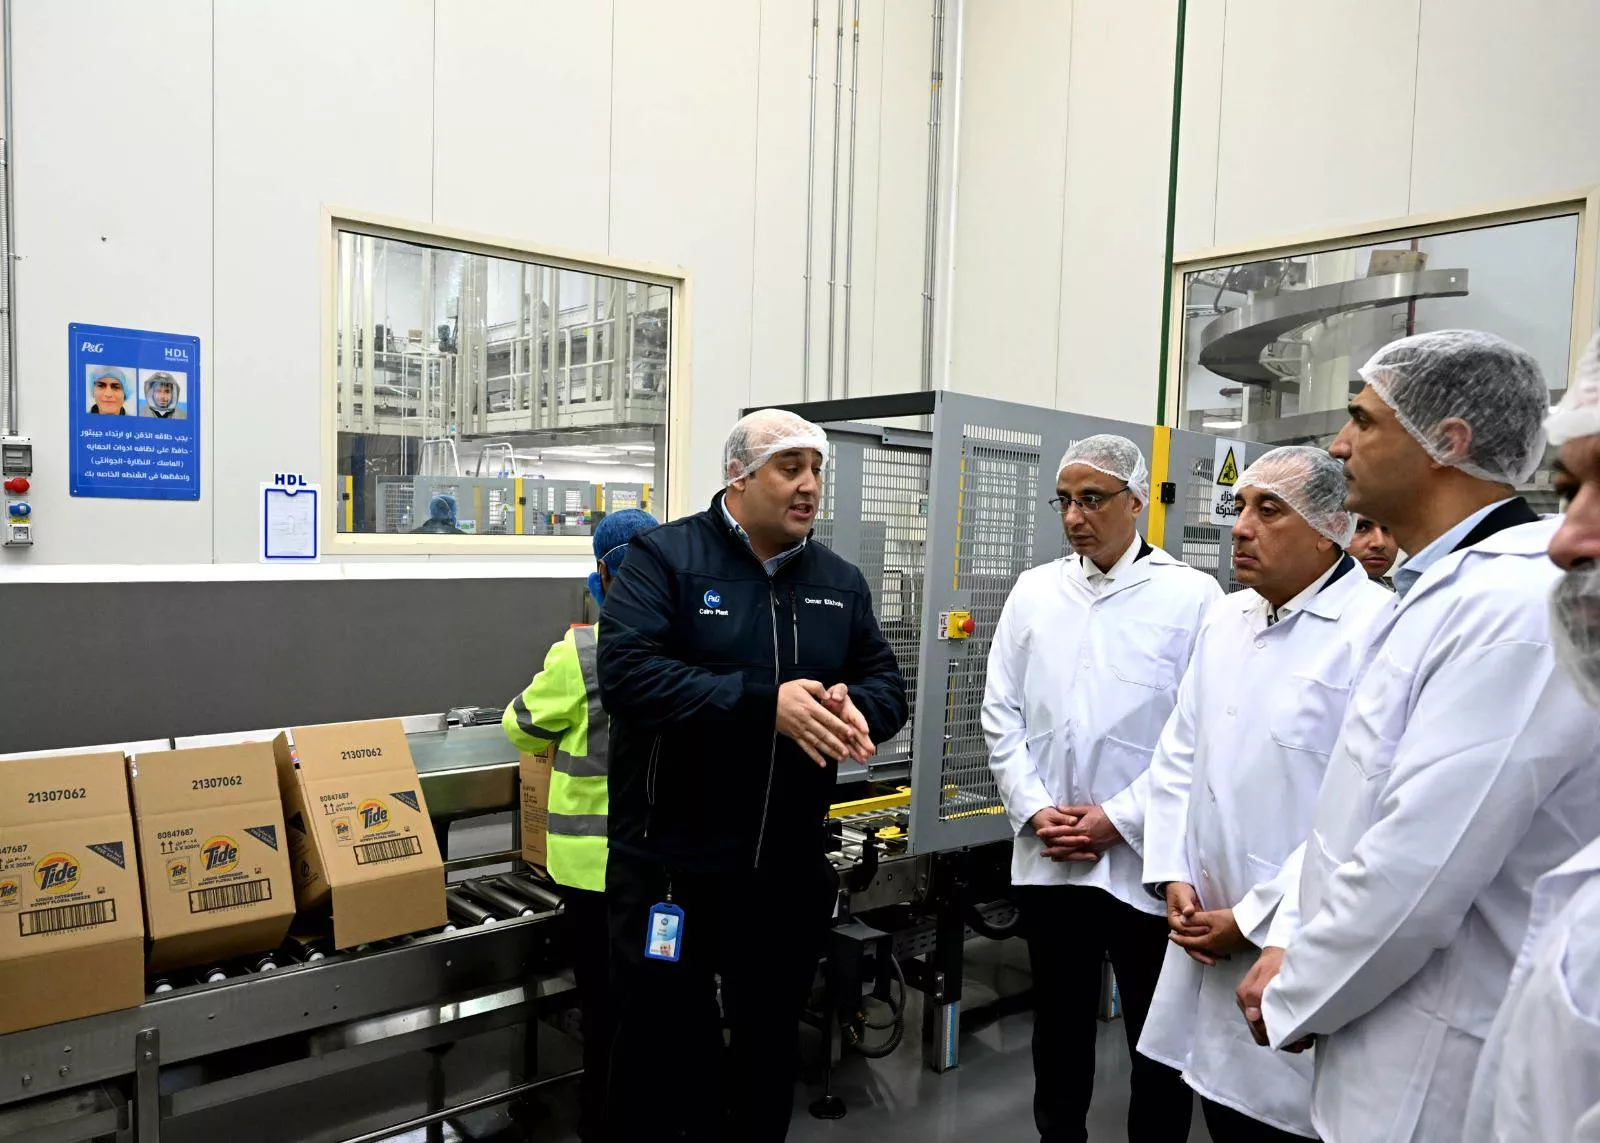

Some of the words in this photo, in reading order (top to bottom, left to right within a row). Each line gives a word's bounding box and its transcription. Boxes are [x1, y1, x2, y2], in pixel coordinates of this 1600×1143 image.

[81, 341, 104, 353] P&G
[164, 347, 188, 358] HDL
[274, 473, 307, 486] HDL
[715, 608, 728, 616] Plant
[341, 747, 383, 760] 21307062
[192, 775, 242, 790] 21307062
[27, 788, 86, 804] 21307062
[360, 806, 388, 829] Tide
[157, 828, 194, 839] 80847687
[203, 844, 238, 871] Tide
[37, 861, 78, 891] Tide
